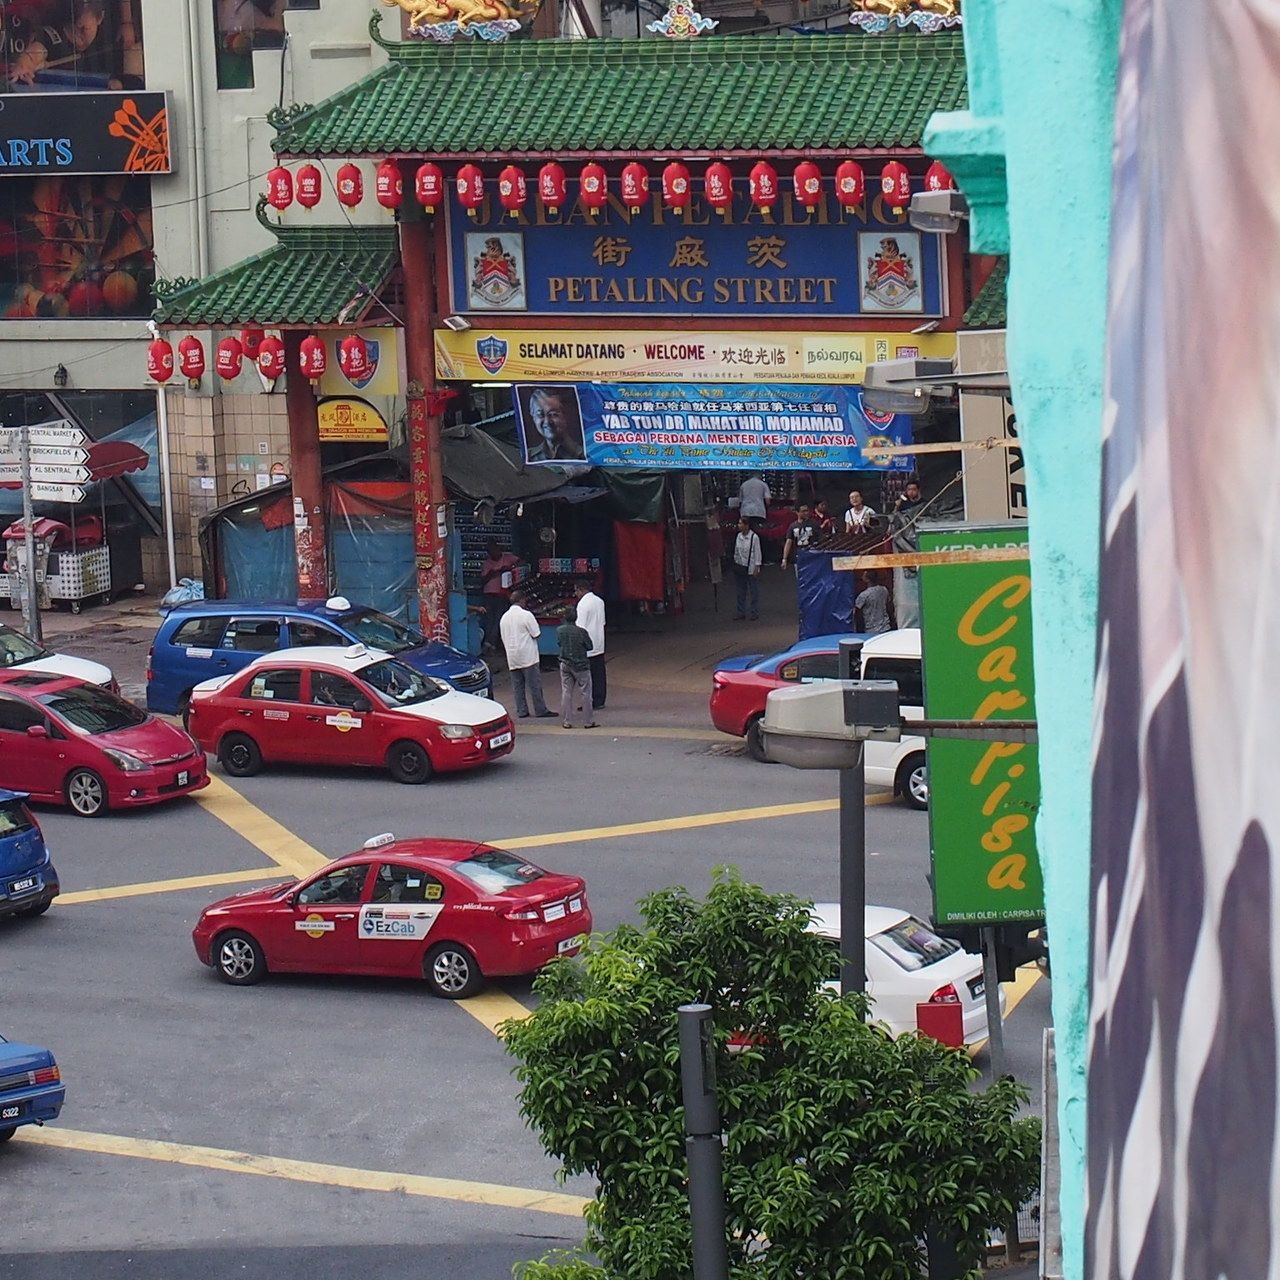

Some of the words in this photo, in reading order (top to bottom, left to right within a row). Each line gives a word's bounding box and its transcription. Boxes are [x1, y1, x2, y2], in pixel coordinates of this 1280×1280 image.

[548, 276, 702, 304] PETALING
[714, 277, 837, 304] STREET
[519, 343, 573, 359] SELAMAT
[577, 344, 625, 359] DATANG
[644, 344, 705, 360] WELCOME
[721, 346, 786, 365] 欢迎光临
[601, 414, 630, 429] YAB
[632, 414, 663, 430] TUN
[665, 414, 686, 430] DR
[688, 414, 763, 431] MAHATHIR
[766, 416, 844, 432] MOHAMAD
[594, 431, 646, 443] SEBAGAI
[650, 432, 704, 444] PERDANA
[707, 433, 758, 444] MENTERI
[762, 434, 789, 444] KE-7
[793, 434, 856, 446] MALAYSIA
[957, 575, 1031, 890] Carpisa
[946, 912, 976, 920] DIMILIKI
[977, 911, 998, 919] OLEH
[1003, 909, 1035, 918] CARPISA
[376, 920, 415, 934] EzCab
